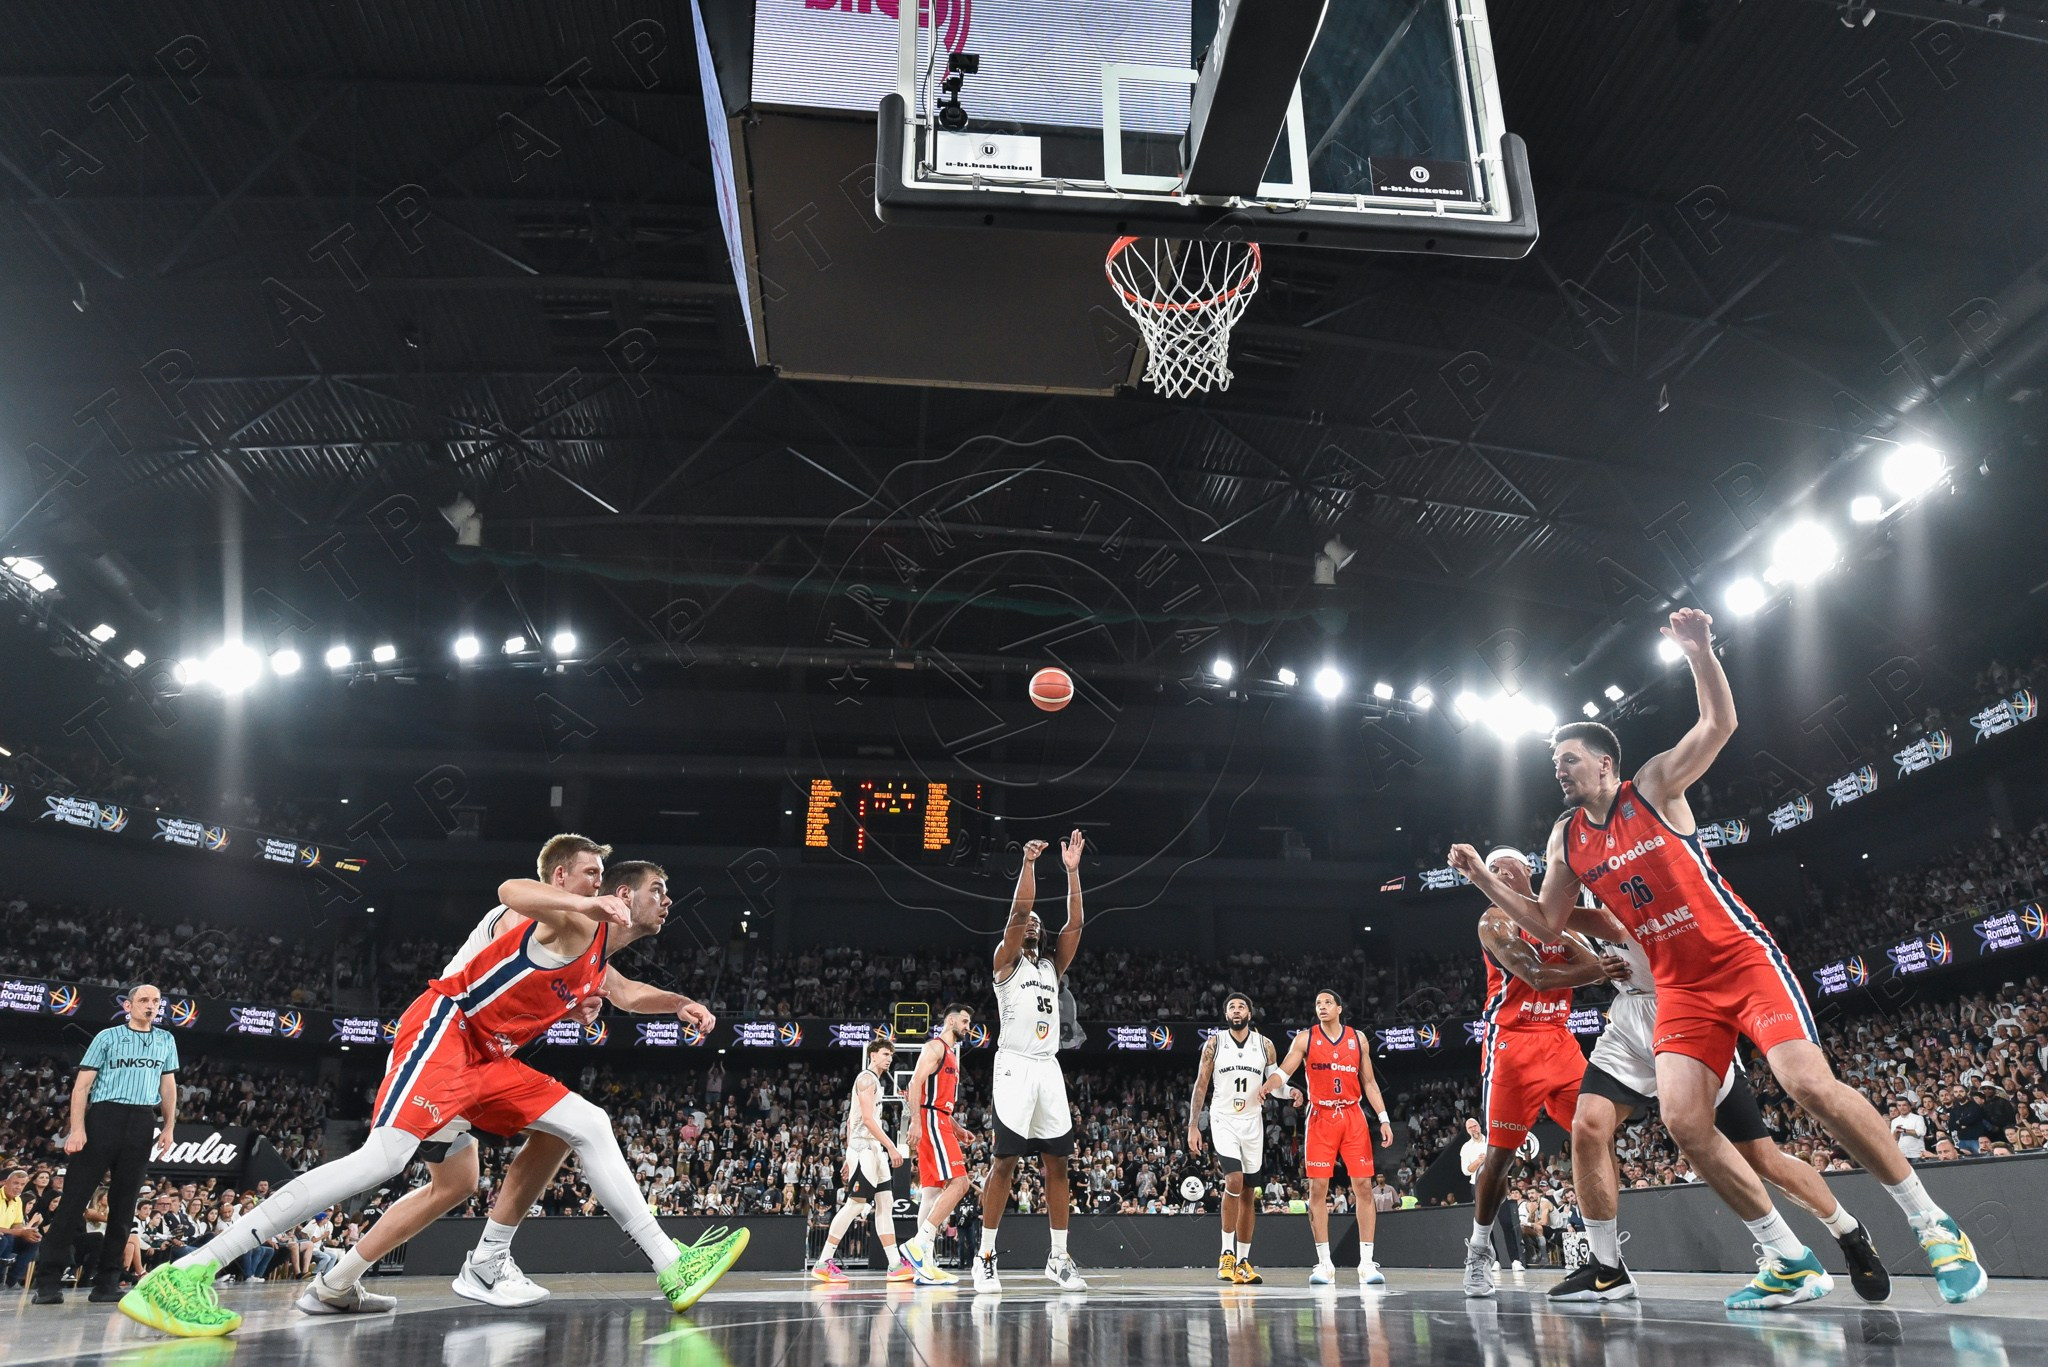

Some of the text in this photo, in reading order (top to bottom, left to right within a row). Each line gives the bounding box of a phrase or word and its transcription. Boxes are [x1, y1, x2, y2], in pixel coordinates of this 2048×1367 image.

[945, 161, 1034, 171] u-bt.basketball
[1380, 185, 1464, 196] u-bt.basketball
[1619, 875, 1655, 910] 26
[1983, 913, 2017, 929] Federația
[1986, 924, 2020, 941] Română
[3, 981, 45, 994] Federația
[0, 990, 43, 1002] Română
[10, 1001, 41, 1011] Baschet
[242, 1008, 276, 1019] Federația
[240, 1015, 275, 1027] Română
[1311, 1062, 1357, 1073] CSMOrade
[1234, 1077, 1247, 1093] 11
[1333, 1078, 1343, 1094] 3
[149, 1127, 238, 1165] inala
